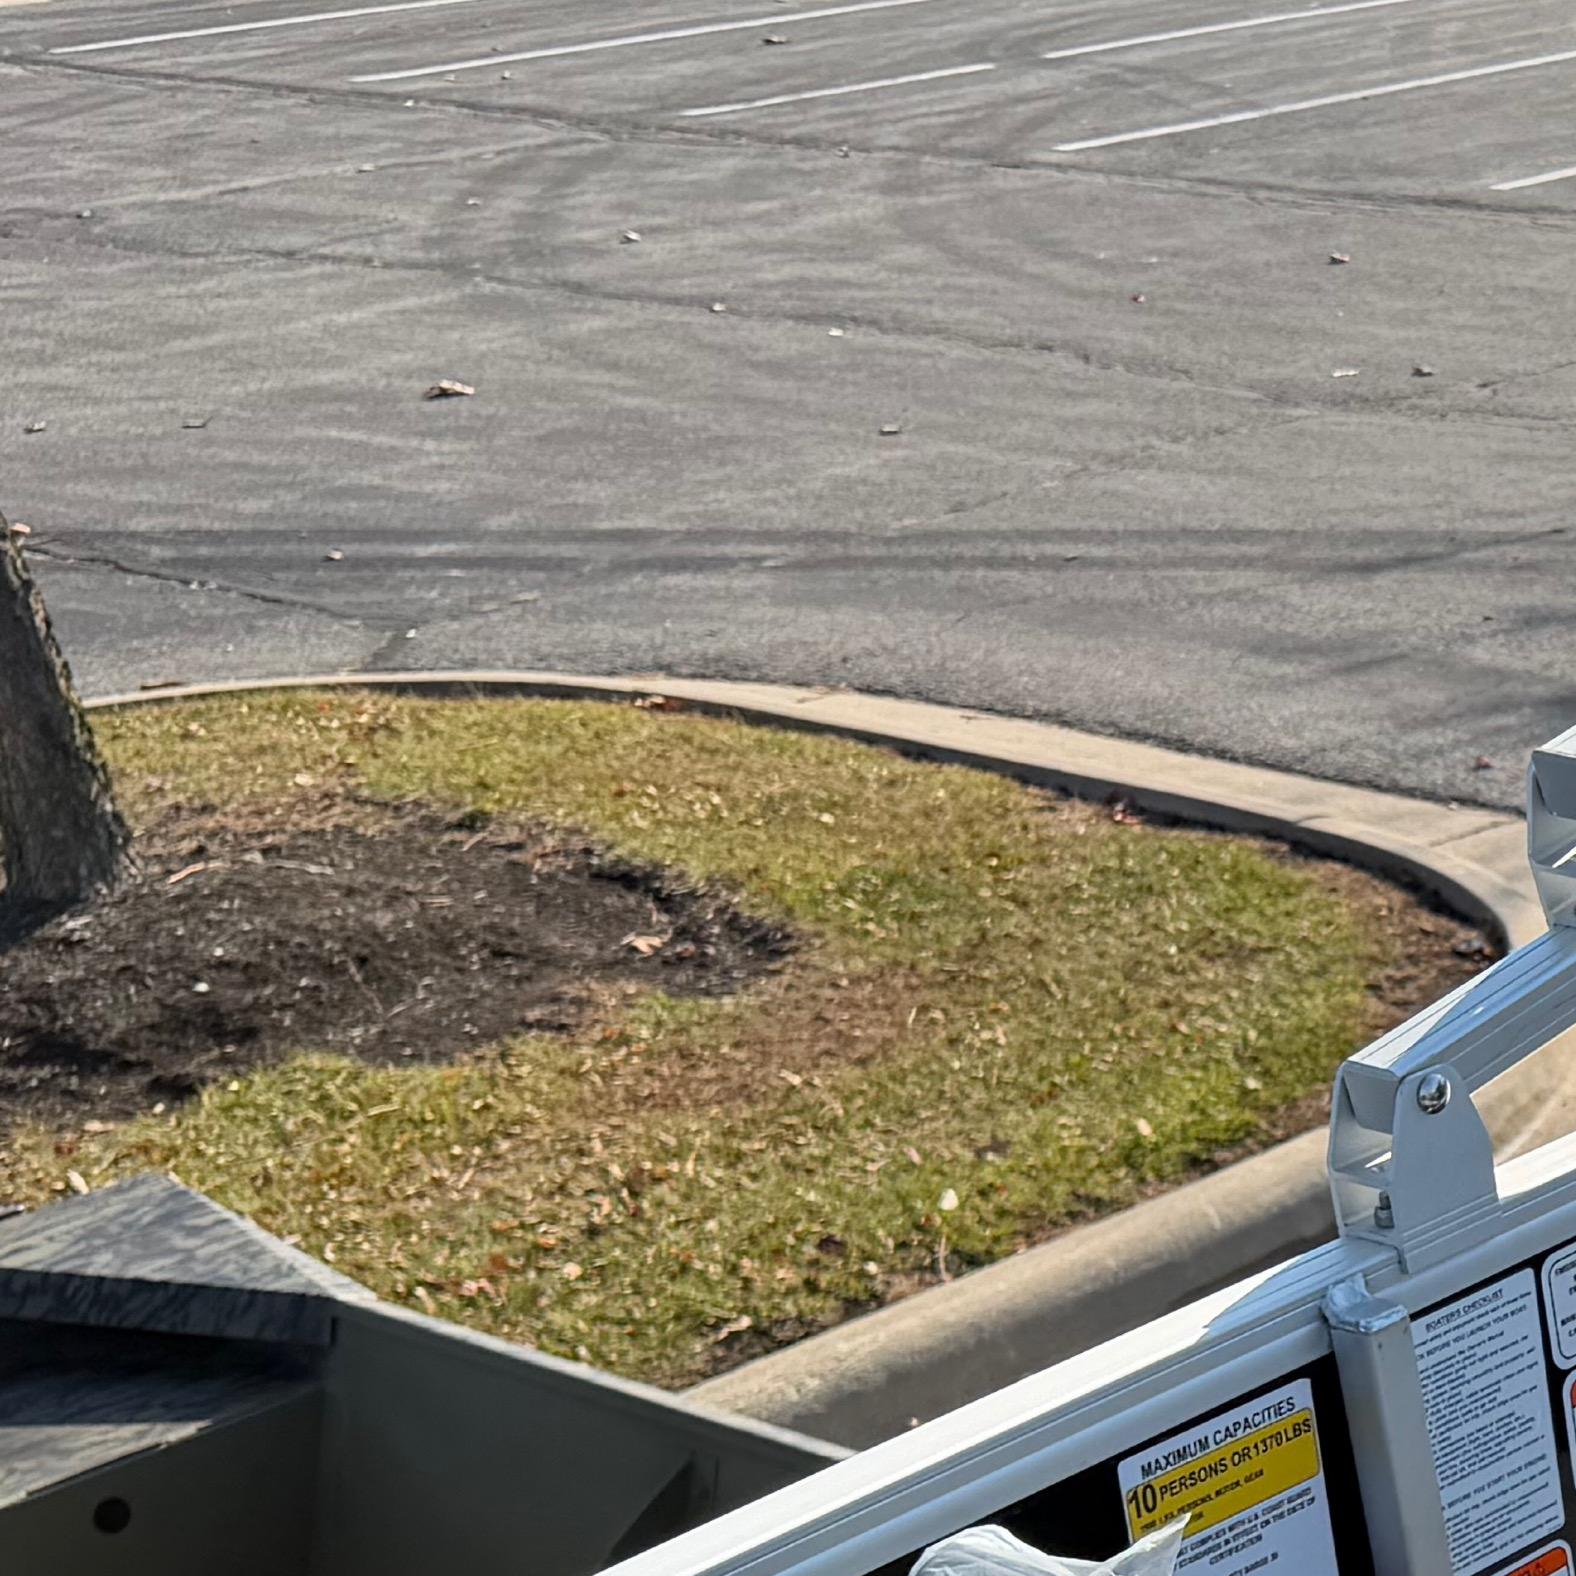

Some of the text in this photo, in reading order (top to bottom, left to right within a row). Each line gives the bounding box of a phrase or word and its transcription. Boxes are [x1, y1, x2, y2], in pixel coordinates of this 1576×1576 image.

[1128, 1485, 1157, 1519] 10
[1158, 1458, 1228, 1502] PERSONS
[1231, 1447, 1252, 1468] OR
[1254, 1433, 1283, 1457] 1370
[1284, 1419, 1312, 1443] LBS
[1140, 1397, 1295, 1480] MAXIMUM CAPACITIES
